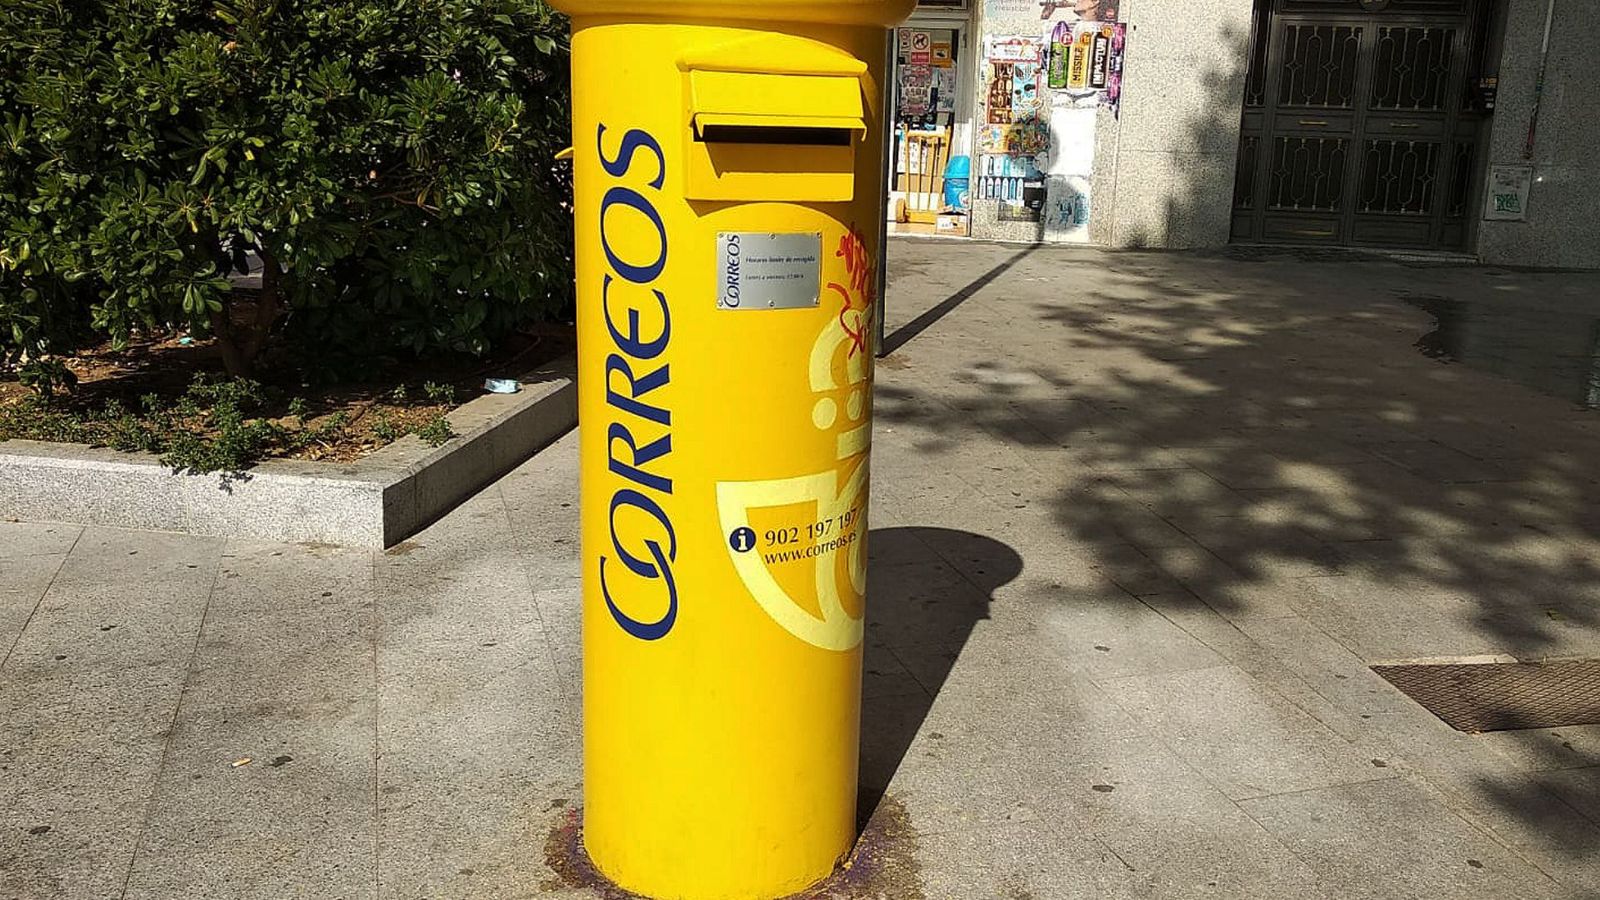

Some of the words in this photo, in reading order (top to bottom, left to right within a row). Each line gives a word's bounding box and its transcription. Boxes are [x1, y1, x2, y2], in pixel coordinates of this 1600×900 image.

[1072, 47, 1083, 81] MISSILE
[723, 234, 741, 308] CORREOS
[597, 122, 678, 641] CORREOS
[764, 527, 799, 547] 902
[806, 519, 833, 540] 197
[838, 509, 857, 530] 197
[764, 530, 857, 565] www.correos.es
